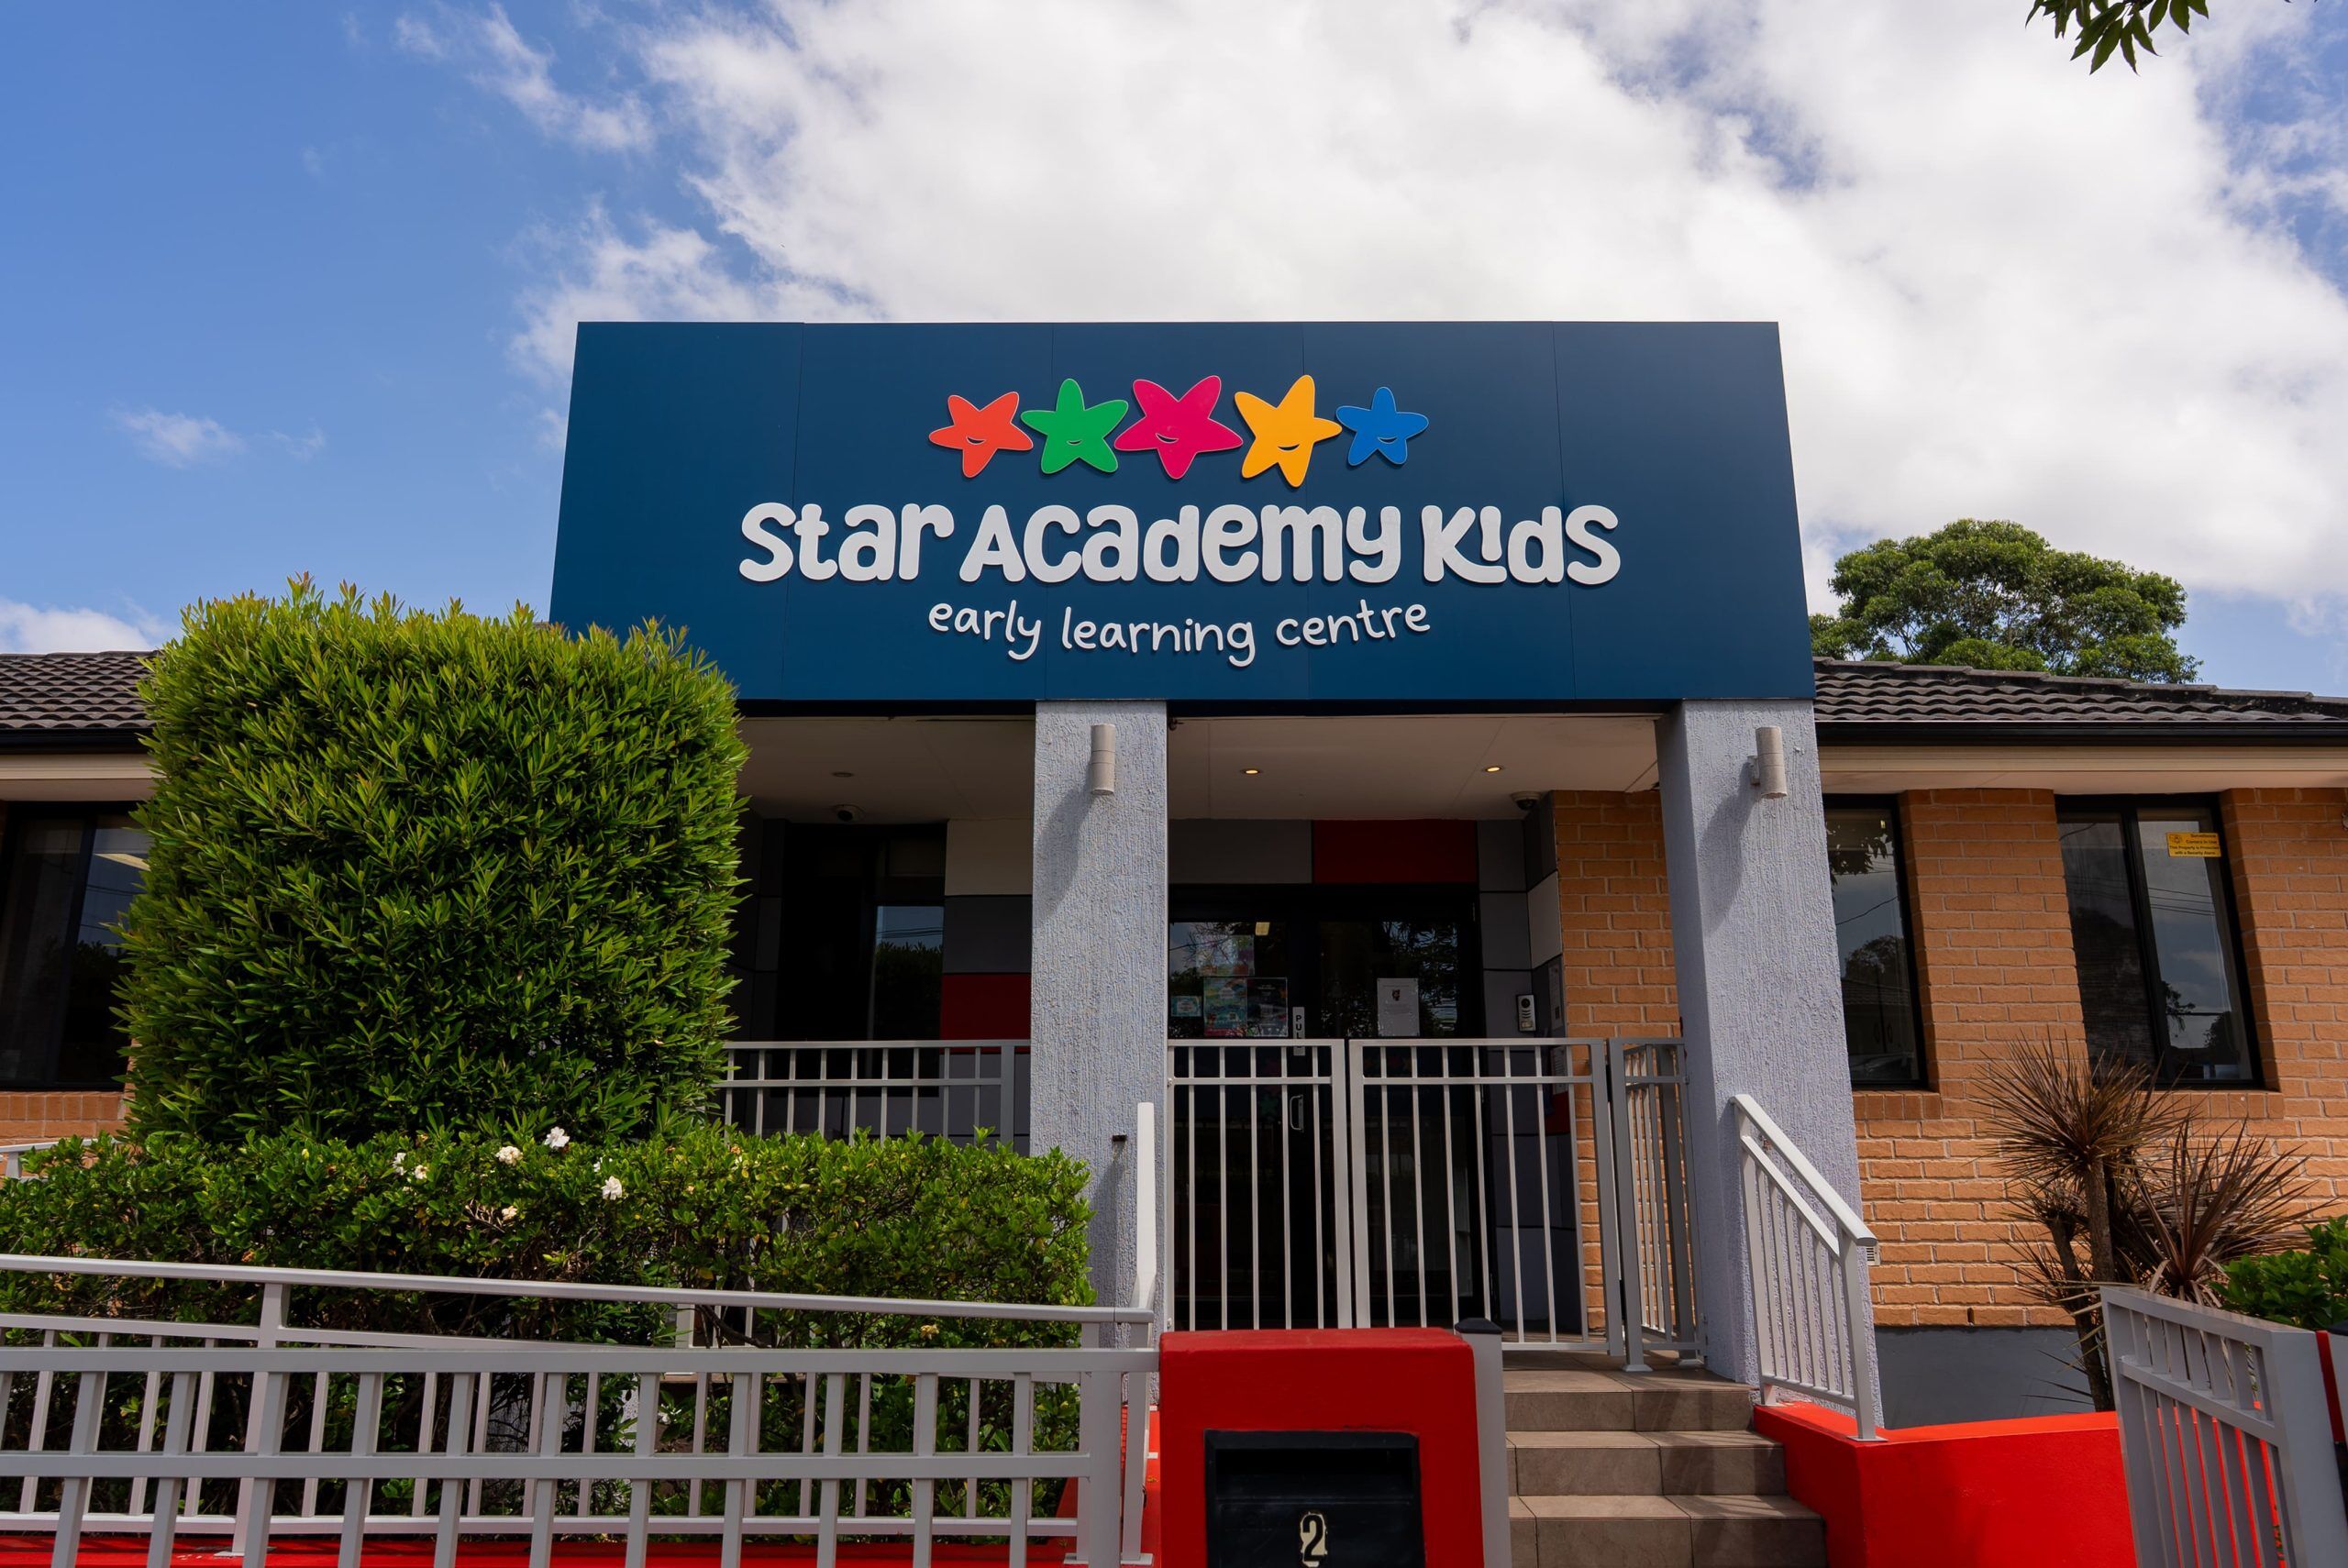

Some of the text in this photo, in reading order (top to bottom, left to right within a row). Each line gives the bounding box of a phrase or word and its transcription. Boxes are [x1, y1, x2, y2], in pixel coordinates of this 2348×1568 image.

[739, 502, 955, 582] Star
[928, 599, 1431, 667] early learning centre
[1302, 1515, 1324, 1562] 2
